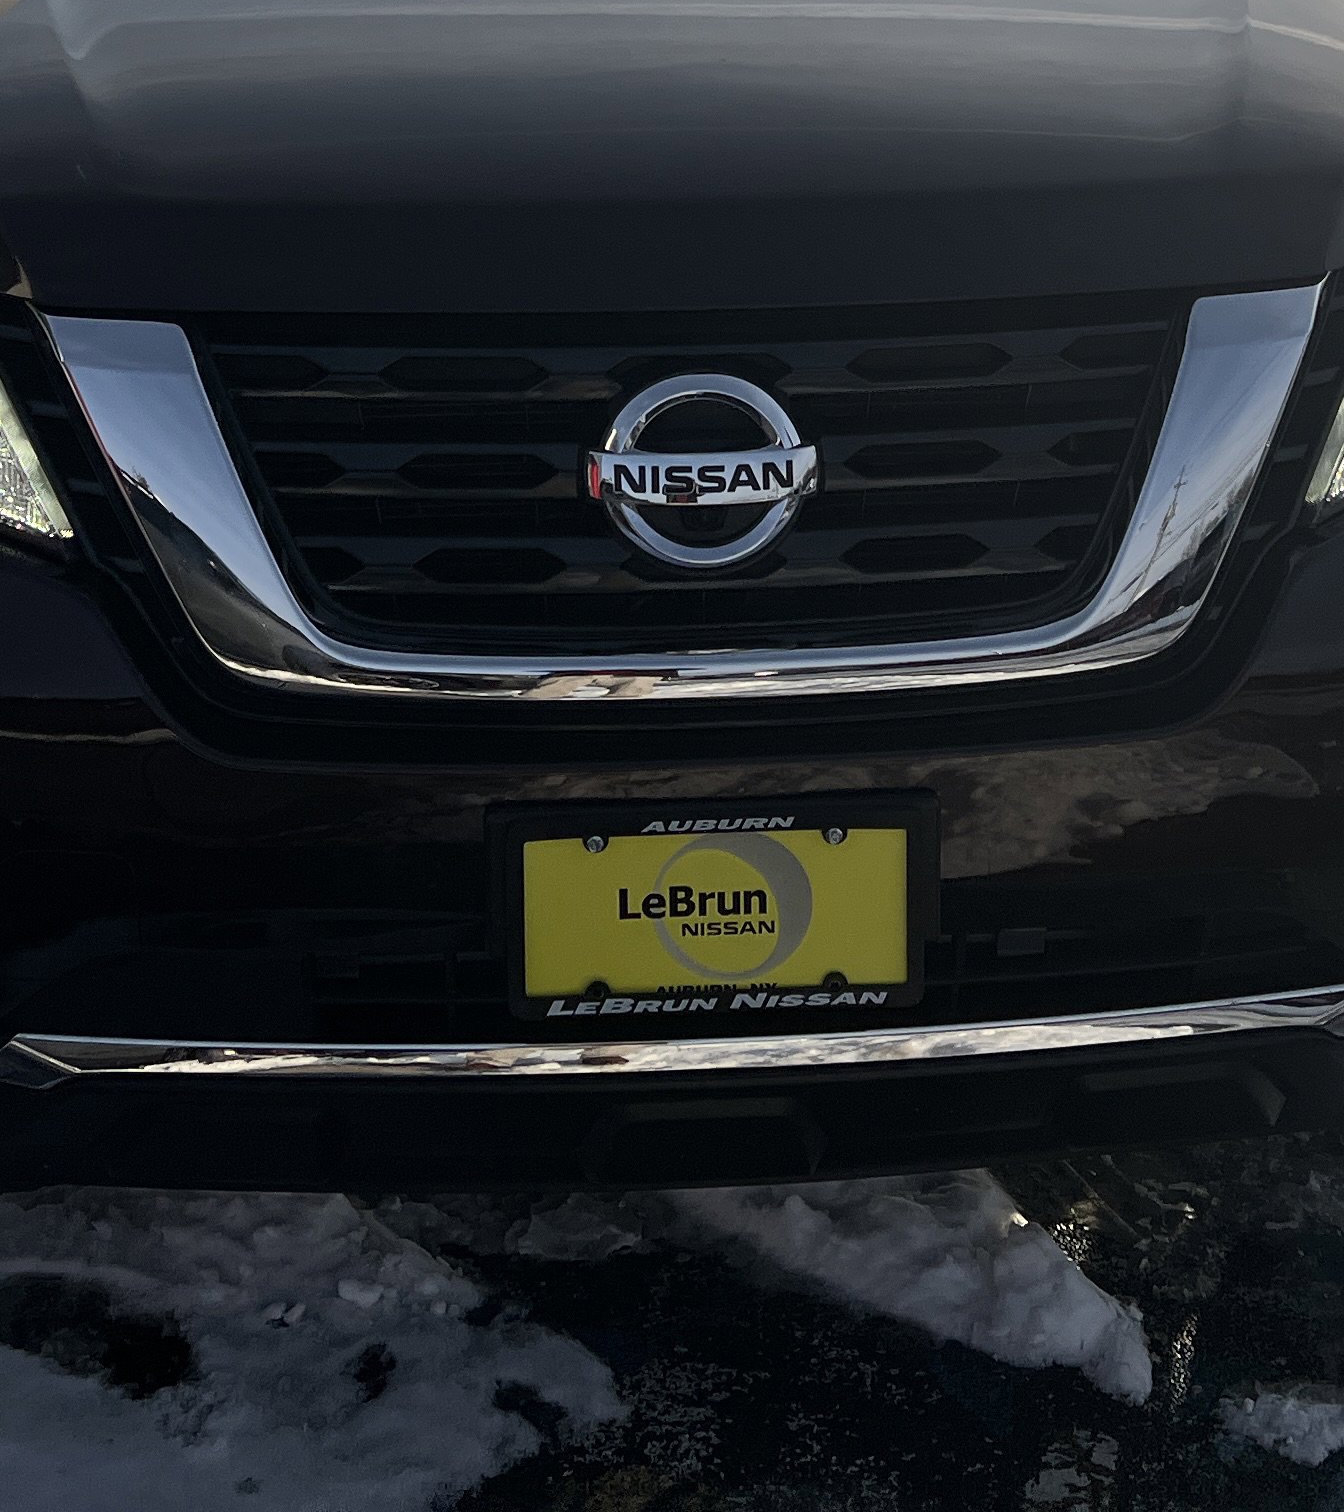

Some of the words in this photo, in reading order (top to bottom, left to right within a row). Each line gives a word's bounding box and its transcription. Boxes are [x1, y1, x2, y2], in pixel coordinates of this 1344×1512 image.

[612, 459, 795, 495] NISSAN
[641, 816, 796, 834] AUBURN
[618, 885, 767, 920] LeBrun
[681, 920, 776, 937] NISSAN
